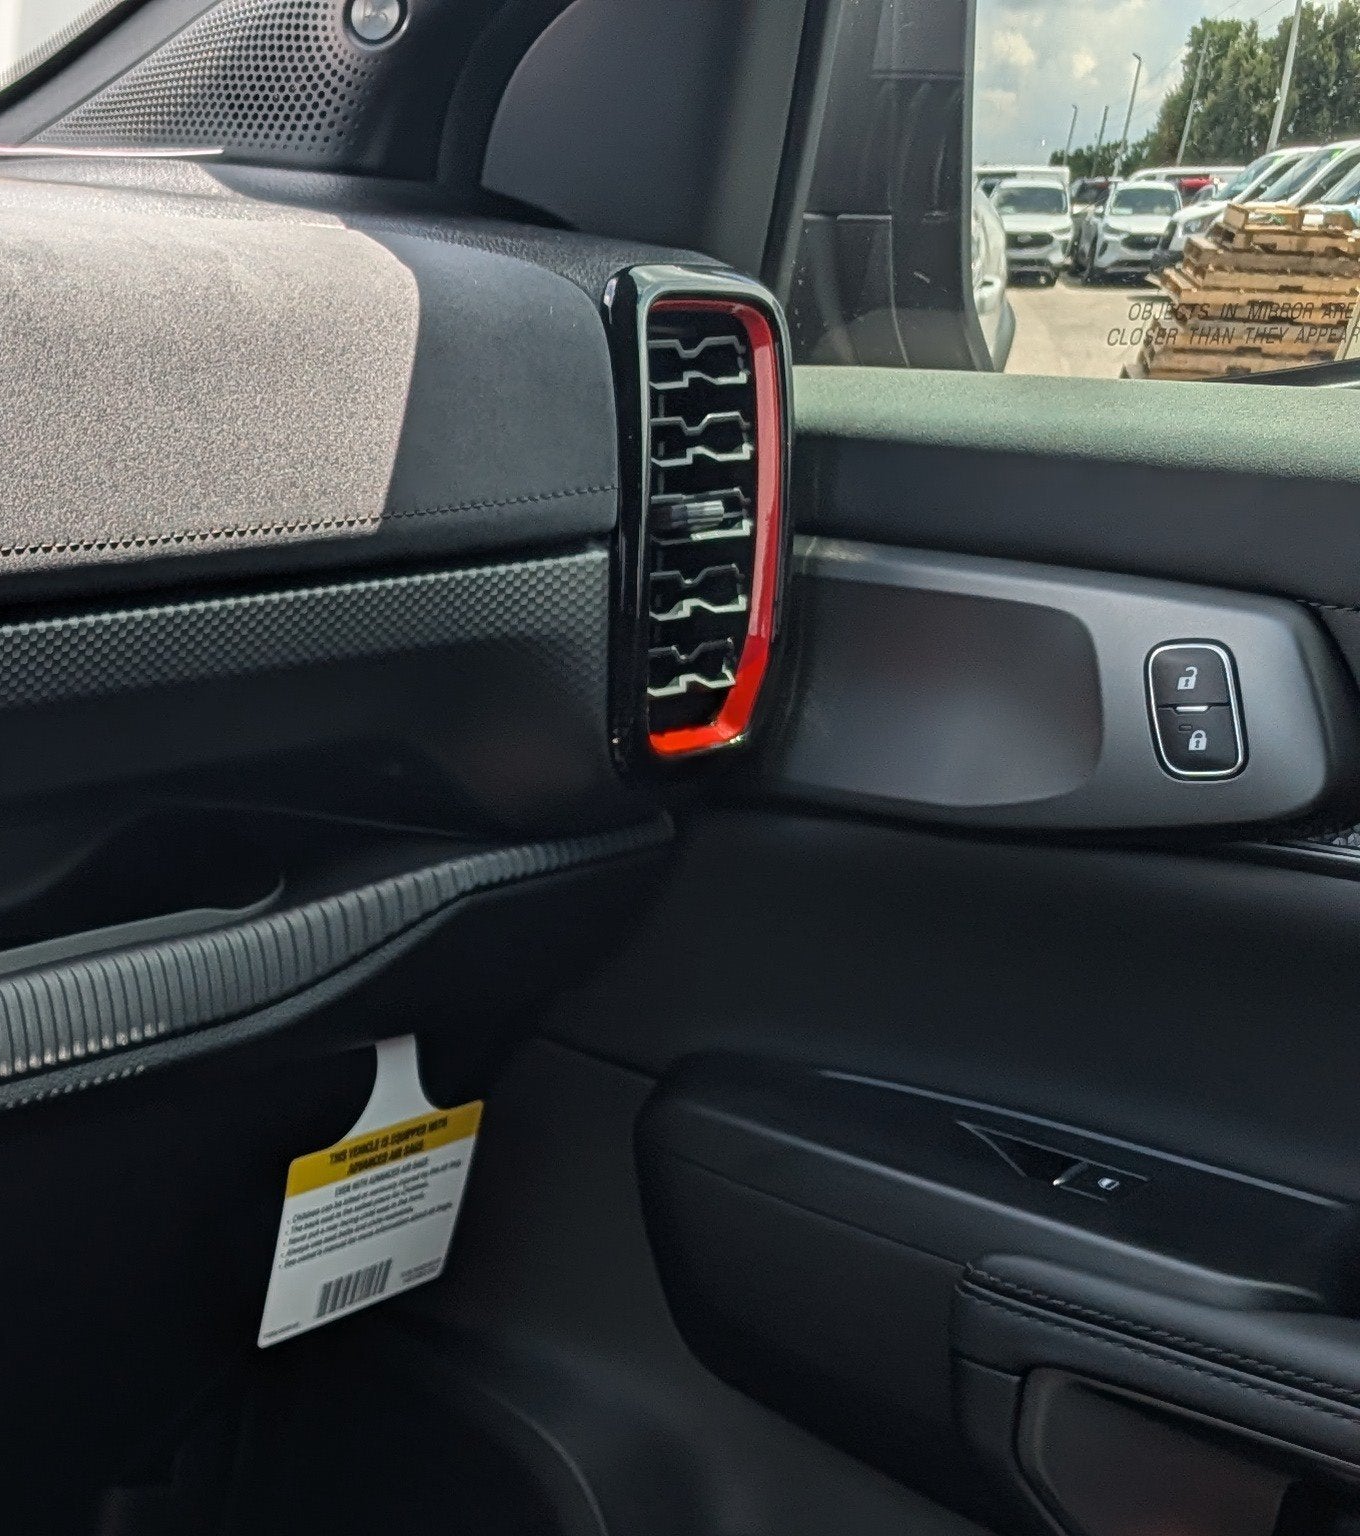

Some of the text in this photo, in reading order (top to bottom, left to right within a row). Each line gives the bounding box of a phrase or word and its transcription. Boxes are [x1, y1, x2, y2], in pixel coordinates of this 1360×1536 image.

[1128, 302, 1357, 321] OBJECTS IN MIRROR ARE
[1107, 327, 1360, 346] CLOSER THAN THEY APPEAR
